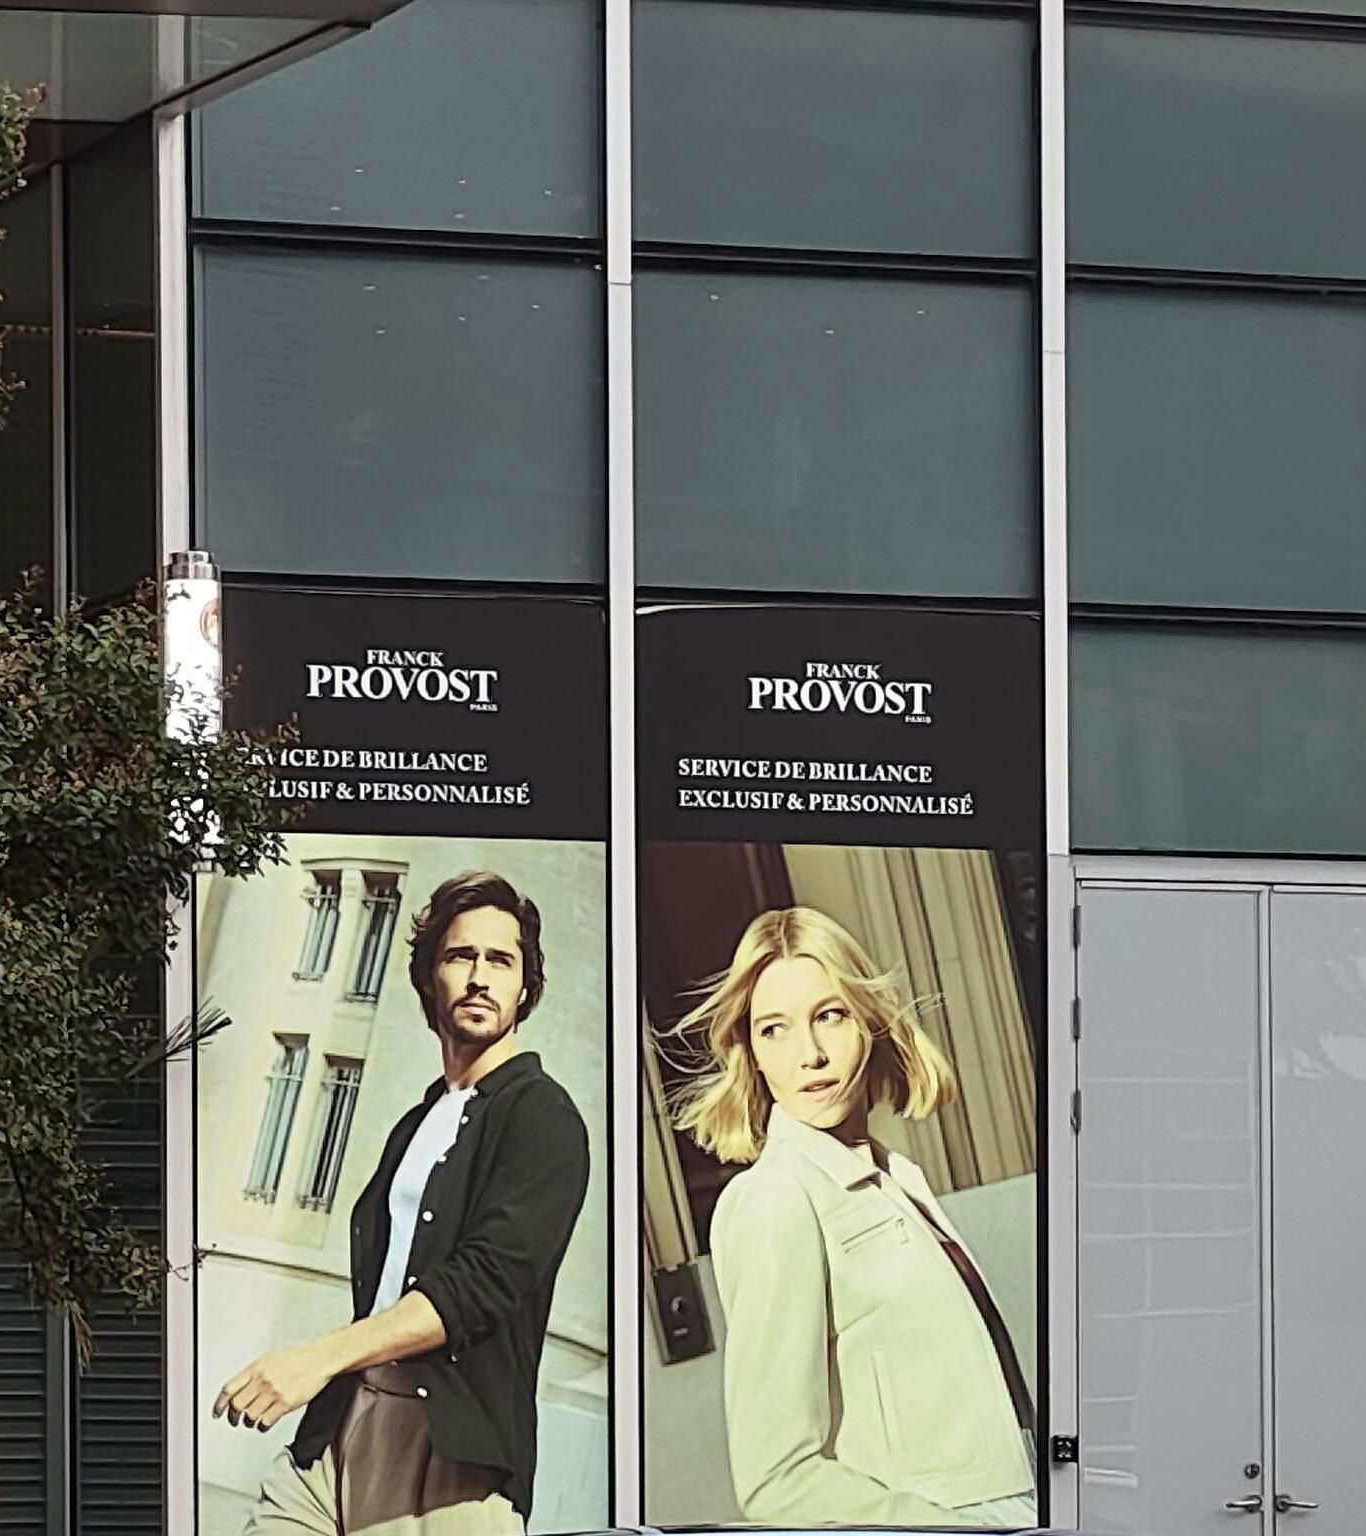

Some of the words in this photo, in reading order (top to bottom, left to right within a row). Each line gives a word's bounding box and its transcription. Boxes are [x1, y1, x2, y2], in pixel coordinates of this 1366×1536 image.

[367, 649, 444, 667] FRANCK
[806, 662, 882, 680] FRANCK
[306, 664, 498, 703] PROVOST
[748, 677, 932, 715] PROVOST
[323, 750, 355, 770] DE
[358, 751, 488, 773] BRILLANCE
[678, 758, 772, 779] SERVICE
[775, 761, 806, 780] DE
[809, 762, 933, 784] BRILLANCE
[268, 779, 333, 800] LUSIF
[335, 782, 355, 800] &
[358, 782, 531, 805] PERSONNALISÉ
[678, 789, 785, 811] EXCLUSIF
[786, 794, 805, 811] &
[809, 792, 974, 815] PERSONNALISÉ
